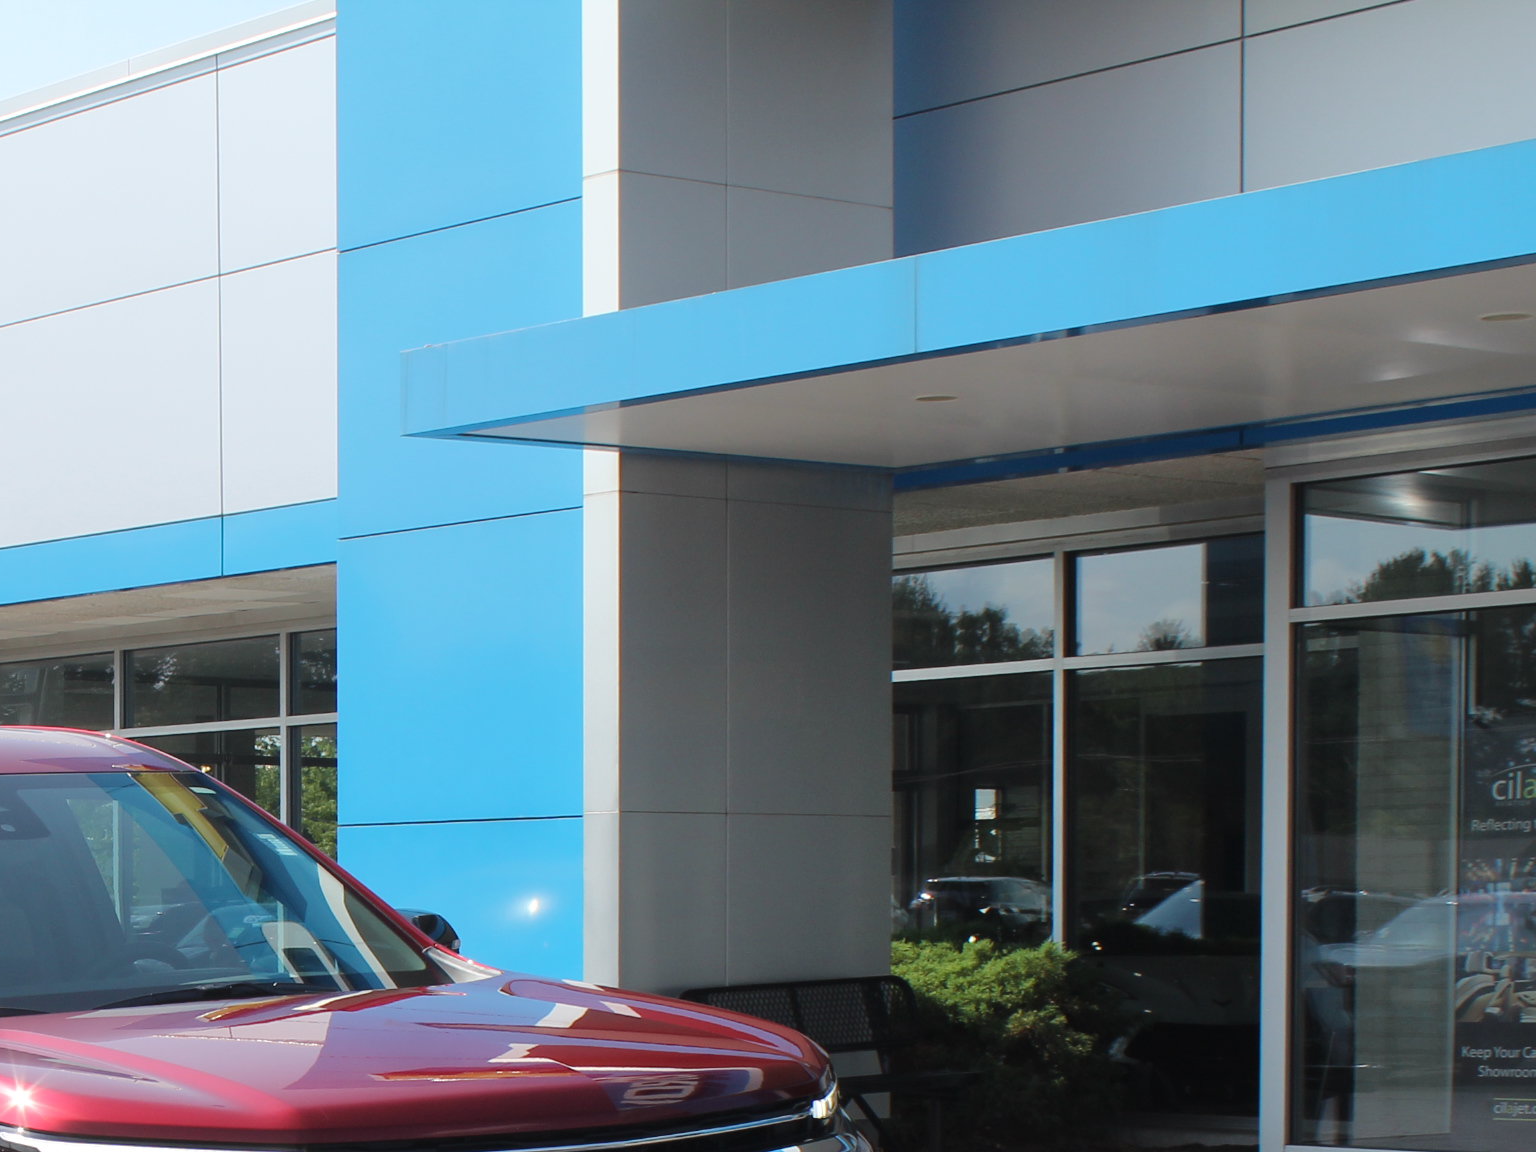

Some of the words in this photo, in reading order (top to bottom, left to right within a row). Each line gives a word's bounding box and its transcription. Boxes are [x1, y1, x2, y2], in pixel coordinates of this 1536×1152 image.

[1471, 818, 1531, 833] Reflecting
[1461, 1046, 1492, 1060] Keep
[1493, 1046, 1520, 1058] Your
